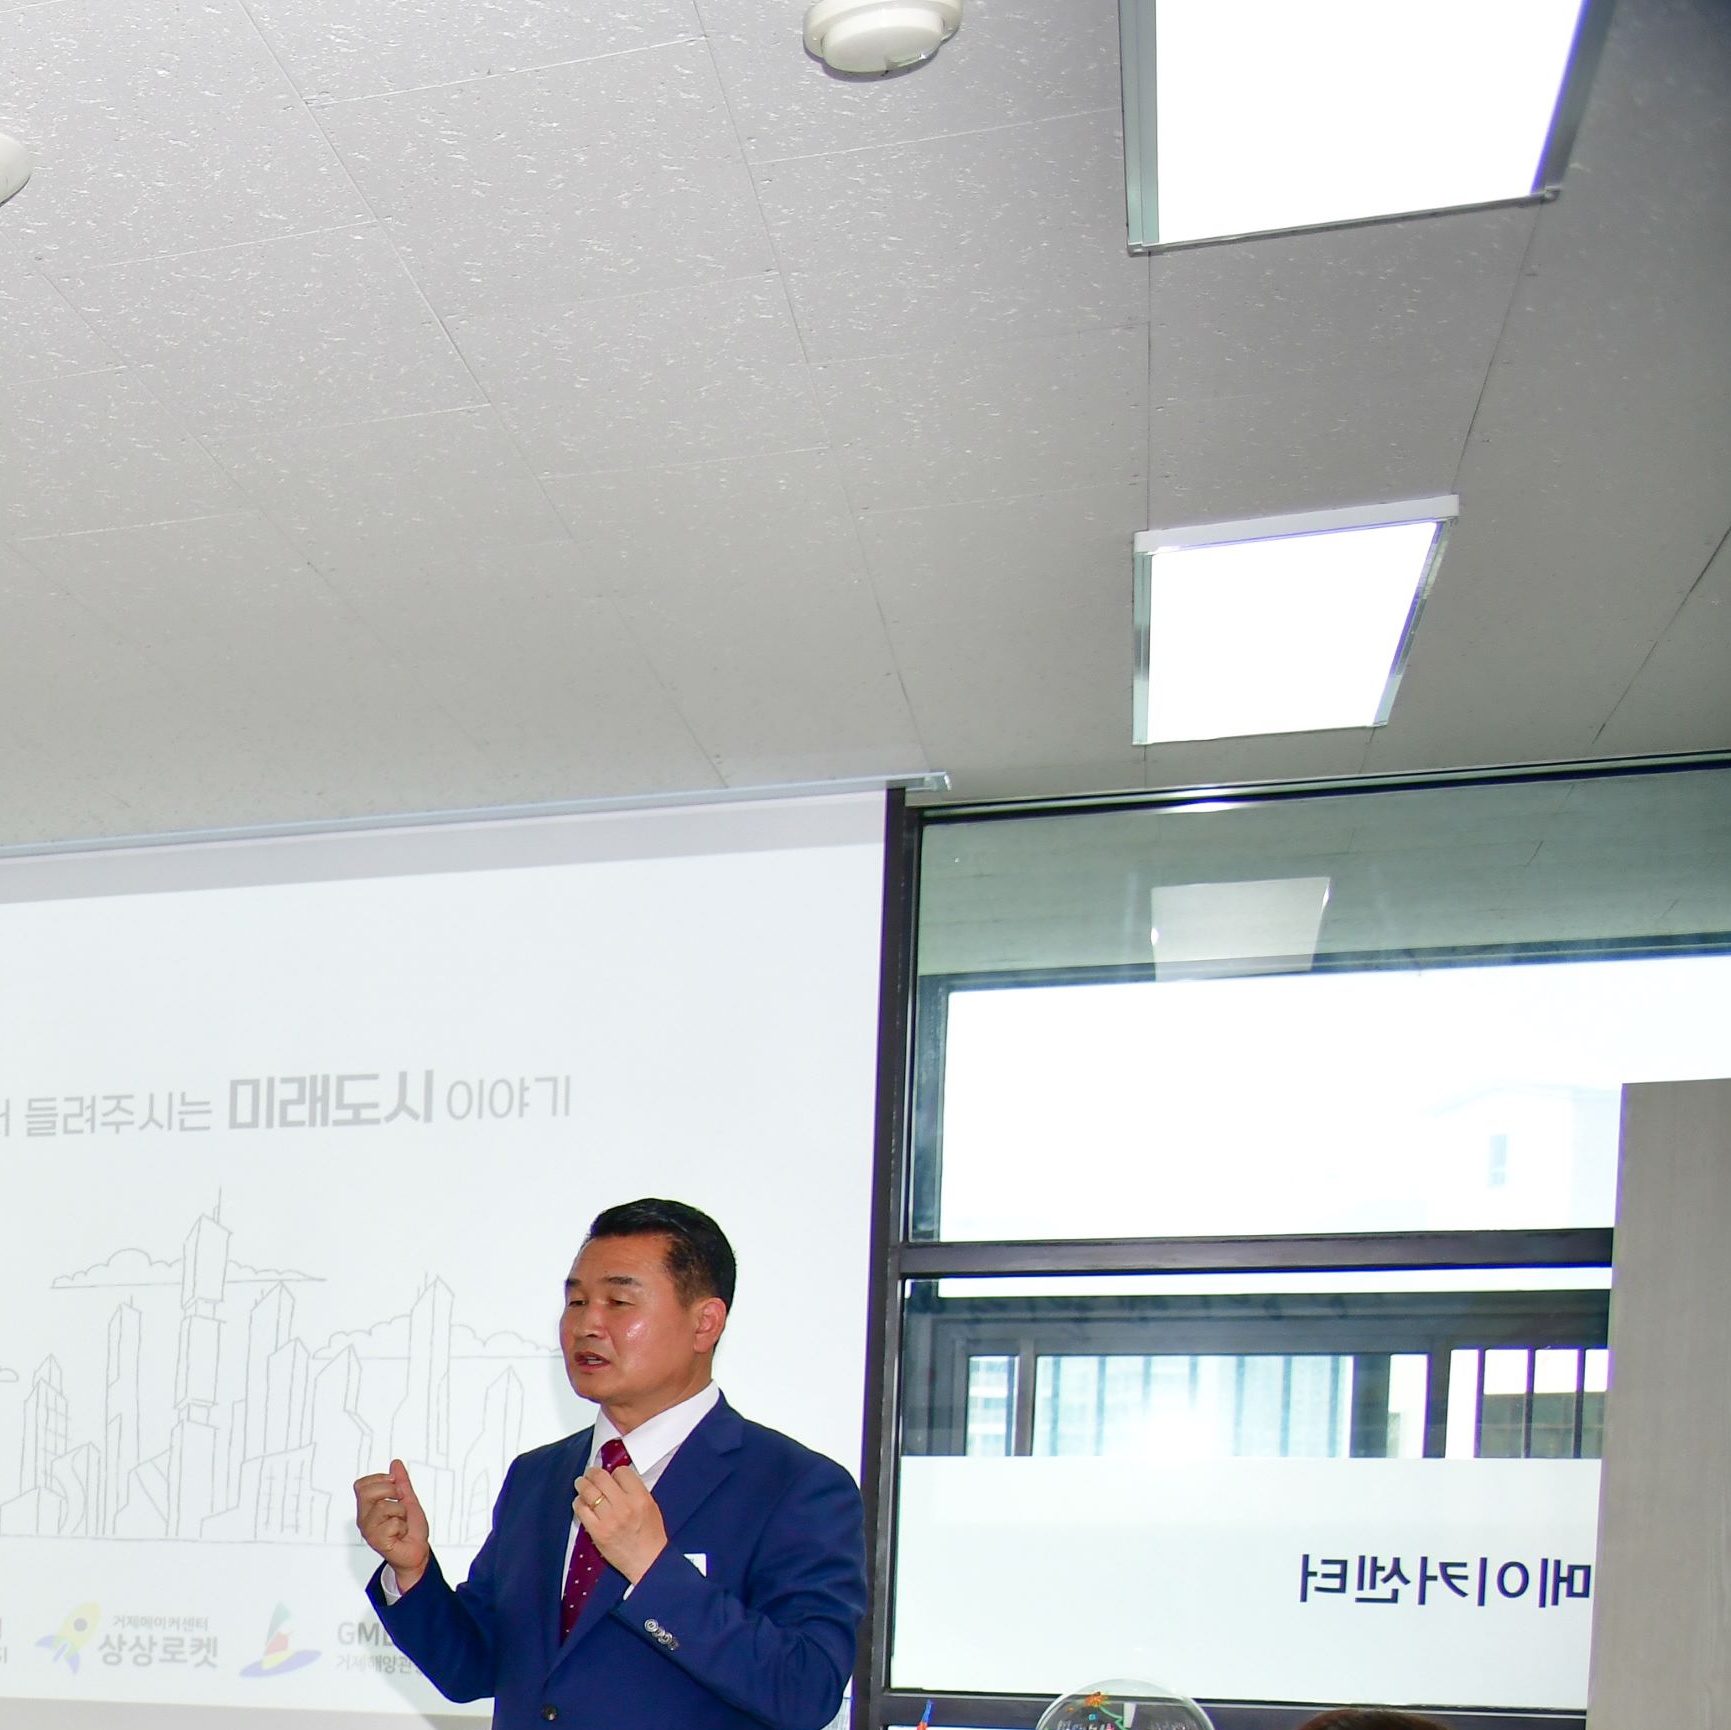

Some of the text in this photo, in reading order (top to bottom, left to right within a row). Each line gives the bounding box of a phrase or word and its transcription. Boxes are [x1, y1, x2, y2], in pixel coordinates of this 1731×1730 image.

[24, 1091, 213, 1137] 들려주시는
[229, 1070, 434, 1130] 미래도시
[446, 1075, 571, 1121] 이야기
[113, 1615, 209, 1632] 거제메이커센터
[98, 1633, 219, 1668] 상상로켓
[336, 1654, 422, 1675] 거제해양관
